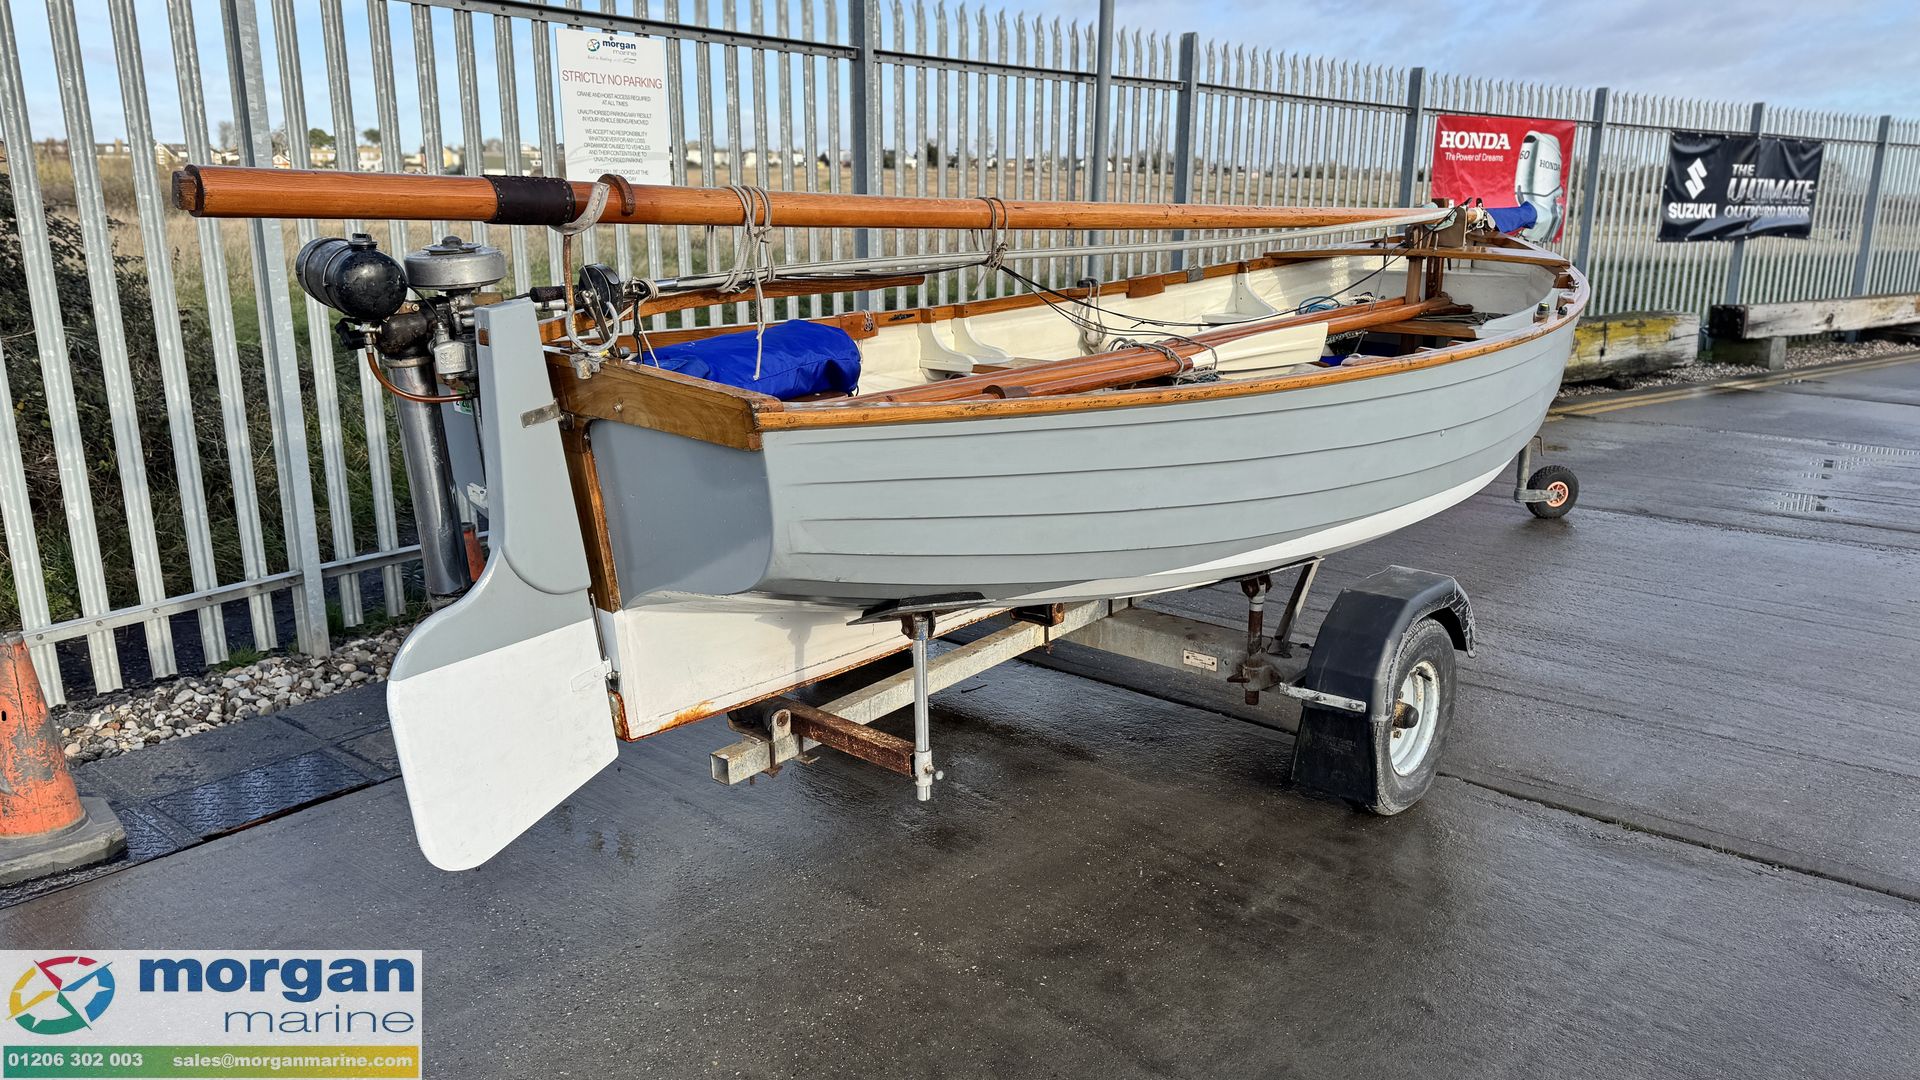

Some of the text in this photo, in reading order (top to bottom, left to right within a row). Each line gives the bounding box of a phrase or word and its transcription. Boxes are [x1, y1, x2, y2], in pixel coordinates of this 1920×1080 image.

[602, 40, 636, 50] morgan
[562, 69, 663, 90] STRICTLY NO PARKING
[614, 93, 631, 101] ACCESS
[577, 109, 610, 117] UNAUTHORISED
[1440, 131, 1511, 150] HONDA
[1445, 152, 1504, 162] The Power of Dreams
[1732, 164, 1755, 177] THE
[1727, 178, 1815, 204] ULTIMATE
[1668, 202, 1717, 219] SUZUKI
[1776, 206, 1810, 219] MOTOR
